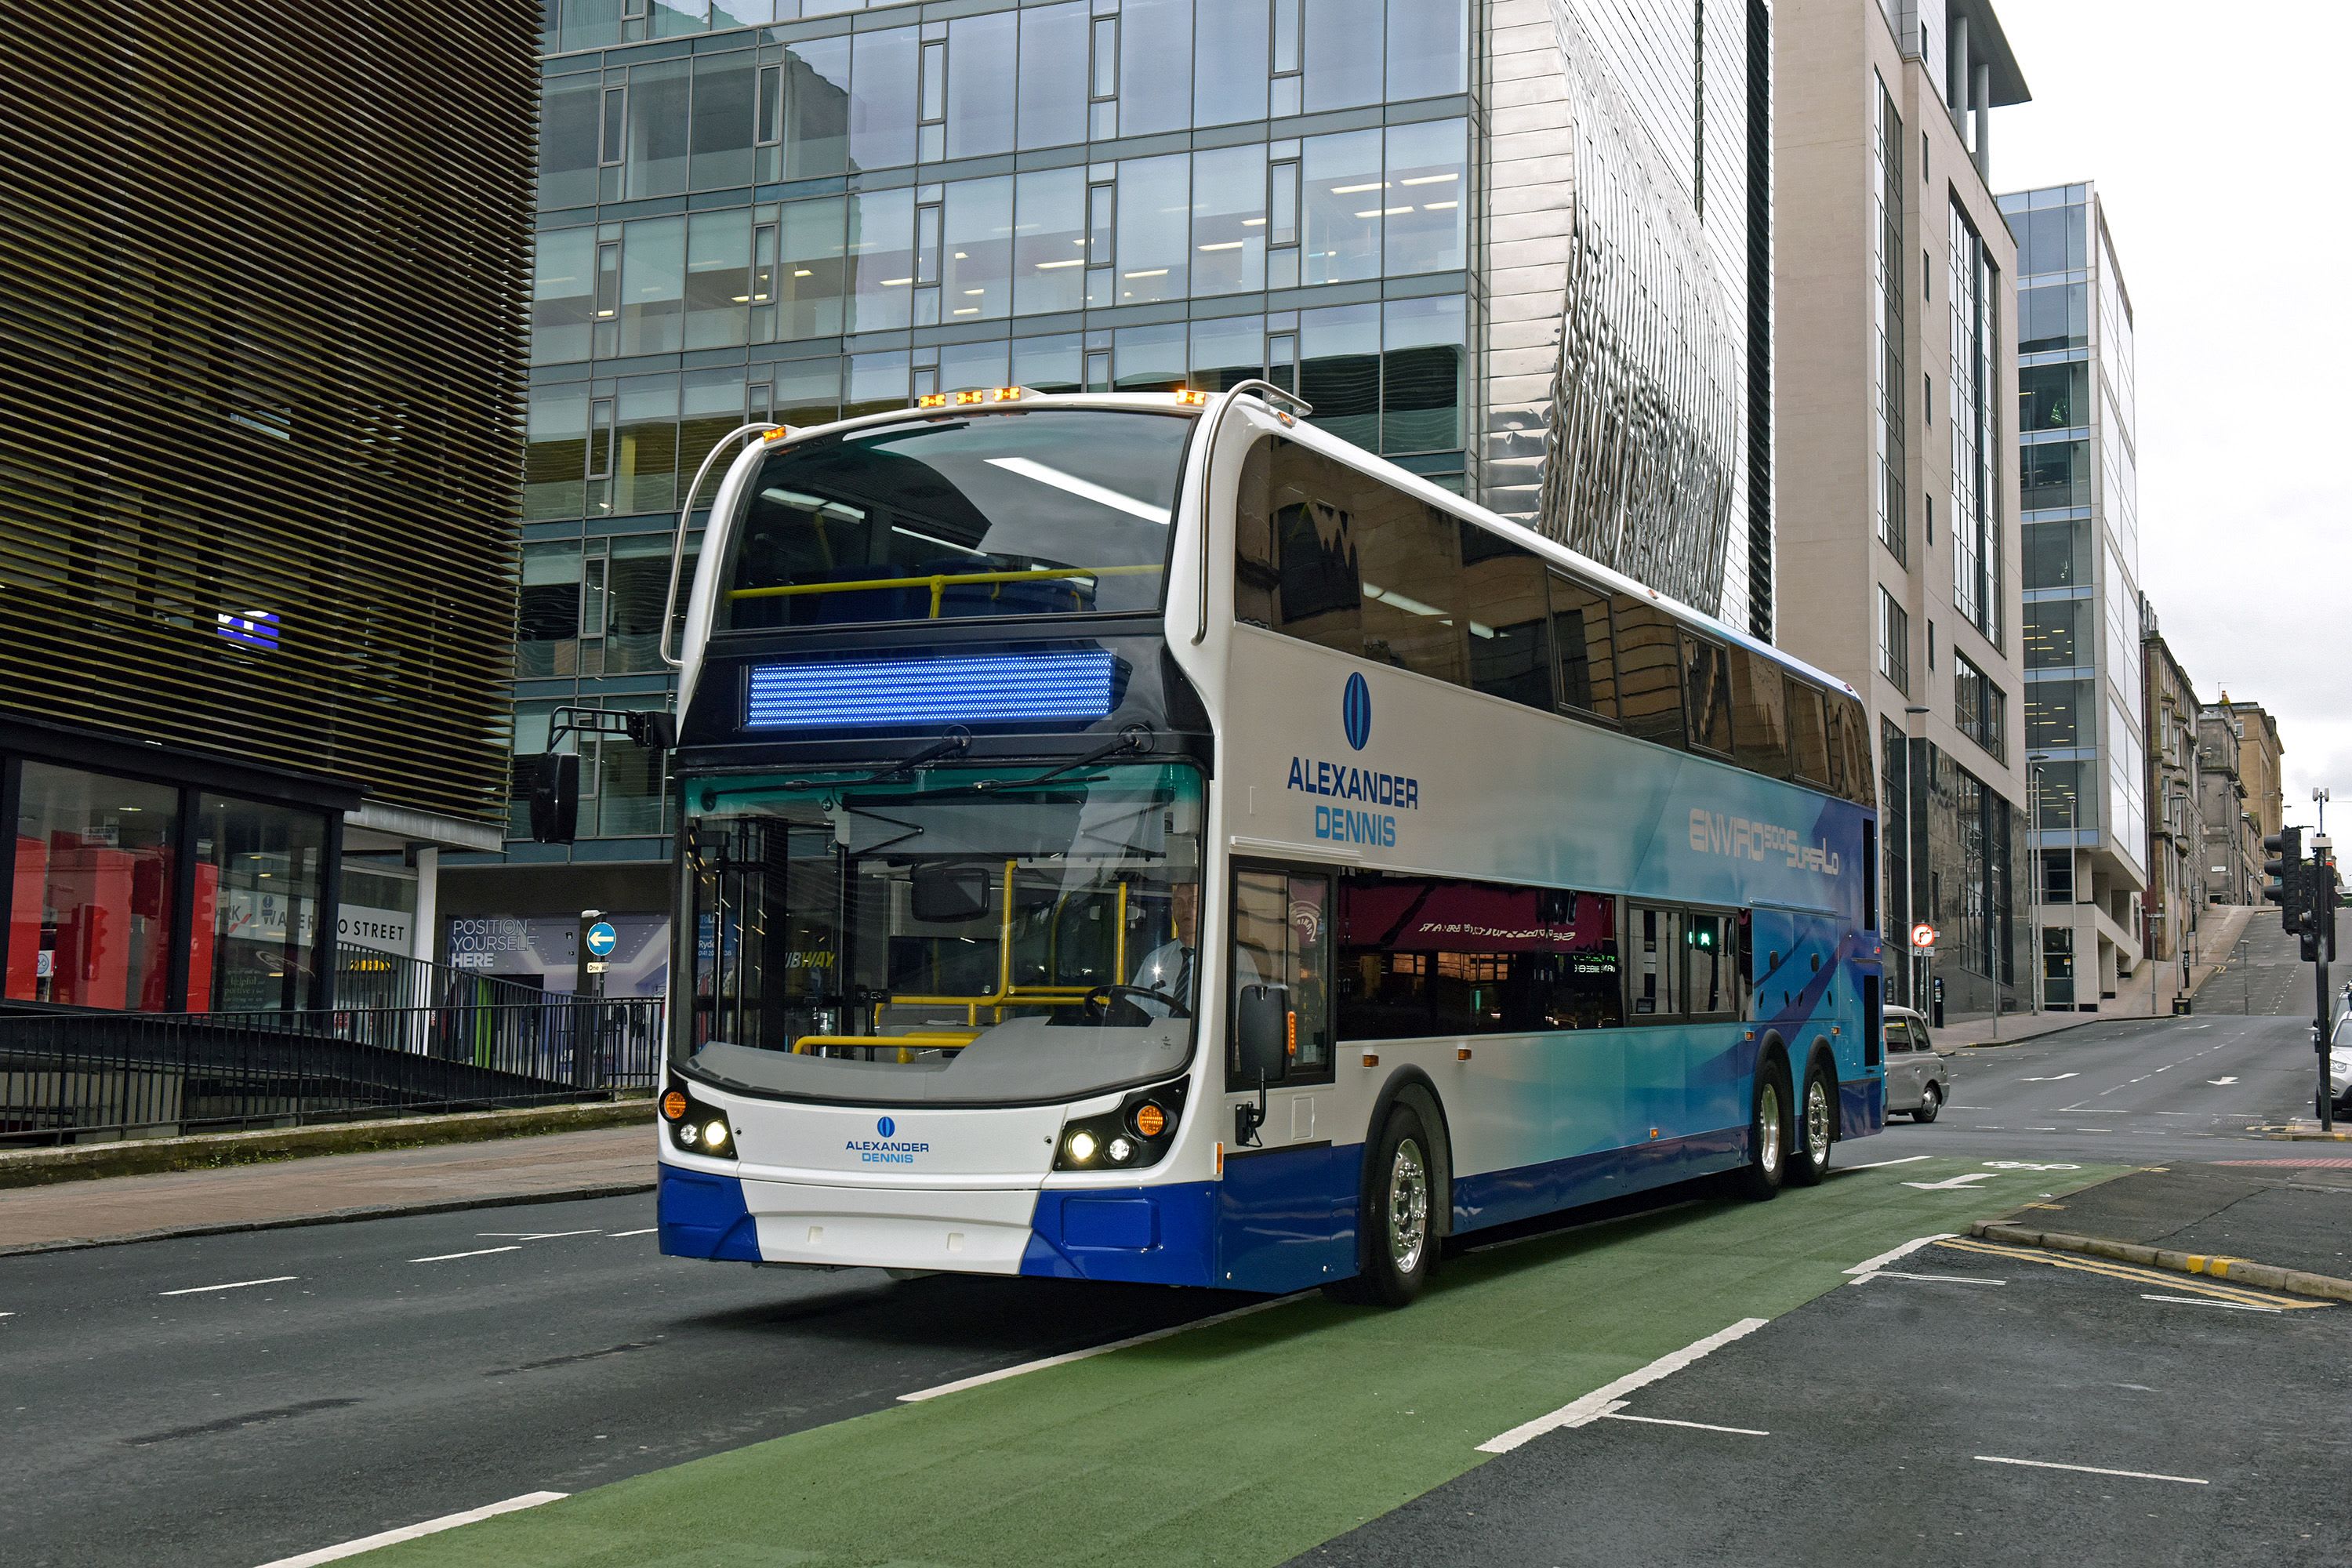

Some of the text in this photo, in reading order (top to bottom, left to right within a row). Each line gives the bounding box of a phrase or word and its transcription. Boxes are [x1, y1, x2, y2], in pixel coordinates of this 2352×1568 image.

[1287, 757, 1418, 810] ALEXANDER
[1316, 805, 1396, 848] DENNIS
[354, 920, 405, 941] STREET
[453, 919, 528, 935] POSITION
[452, 935, 537, 952] YOURSELF
[699, 940, 715, 949] Ryde
[452, 953, 495, 968] HERE
[785, 951, 836, 969] UBWAY
[846, 1141, 929, 1152] ALEXANDER
[862, 1152, 913, 1163] DENNIS
